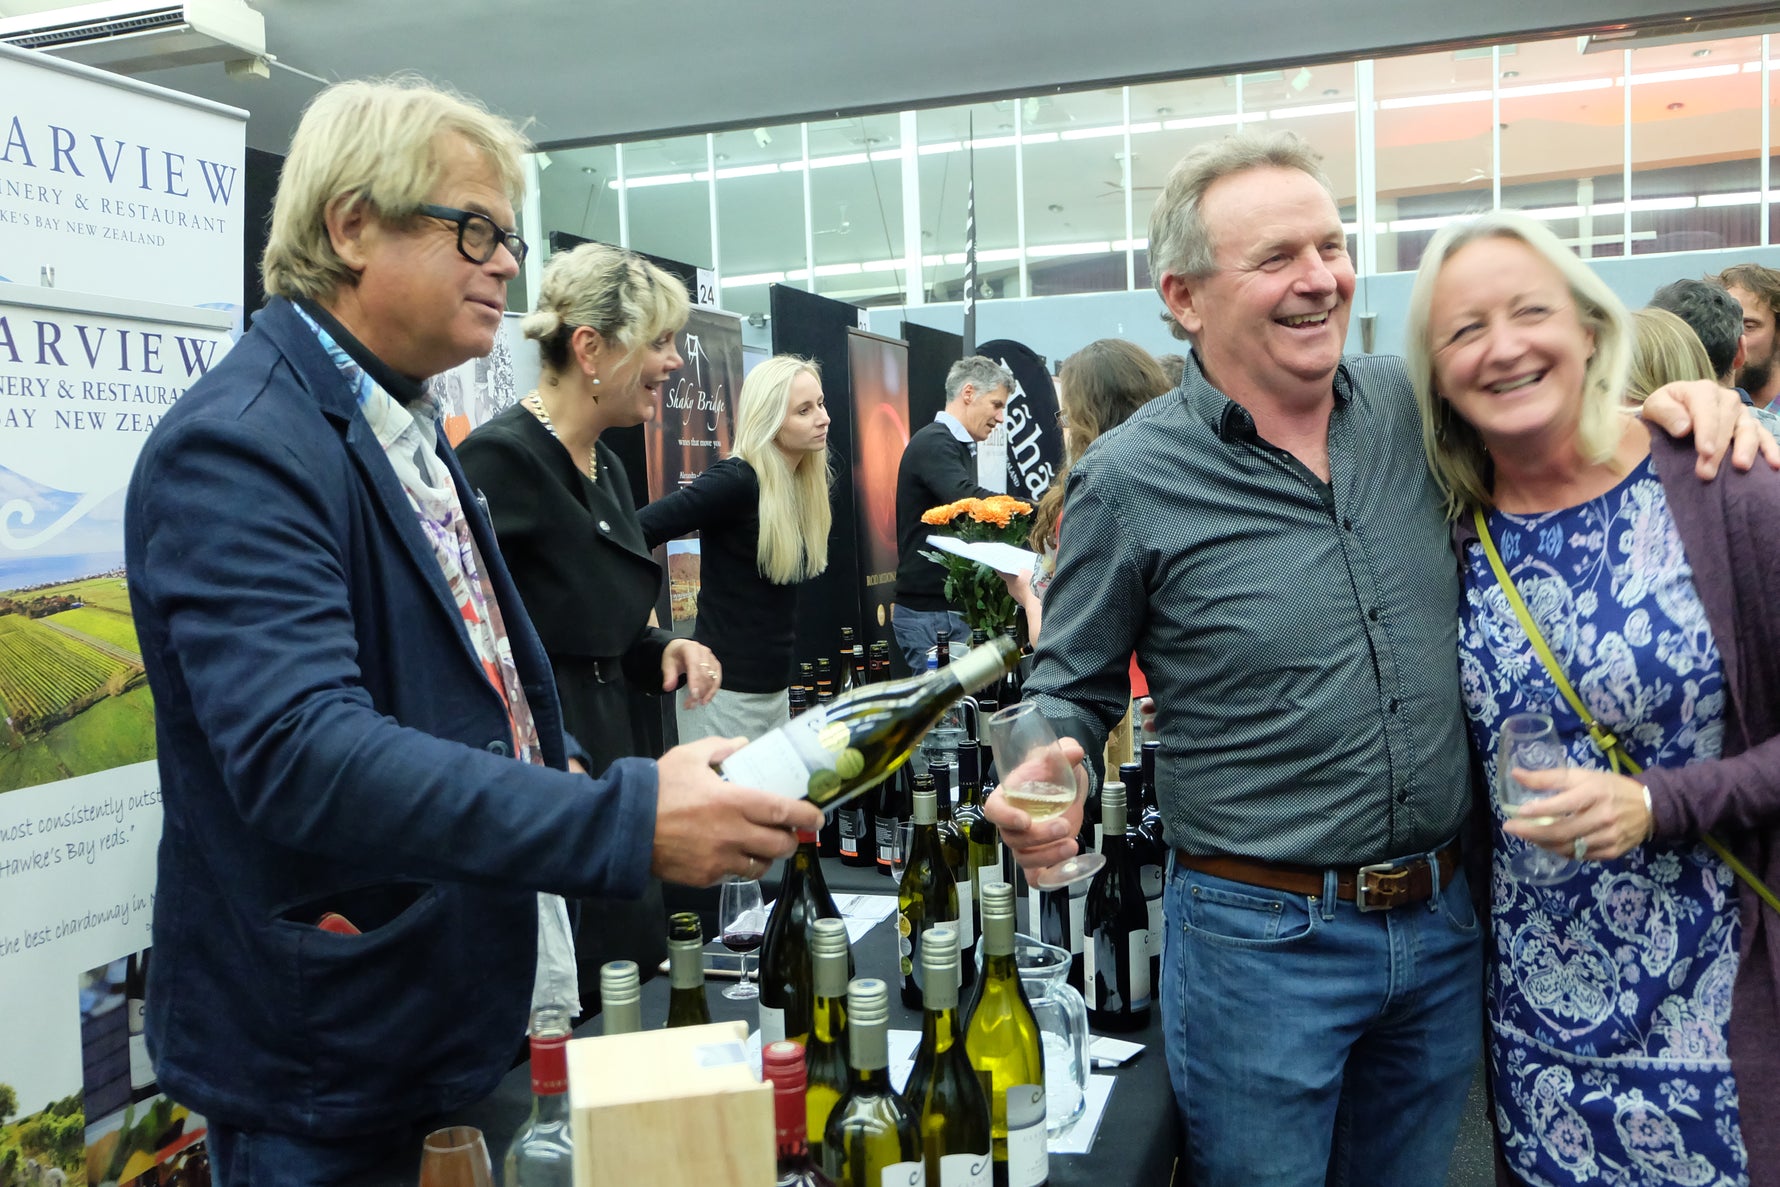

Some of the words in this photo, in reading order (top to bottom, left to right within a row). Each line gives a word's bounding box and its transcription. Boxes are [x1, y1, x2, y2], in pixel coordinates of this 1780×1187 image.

[0, 114, 238, 207] ARVIEW
[35, 215, 61, 232] BAY
[66, 220, 97, 237] NEW
[103, 226, 165, 247] ZEALAND
[74, 193, 90, 211] &
[101, 197, 226, 234] RESTAURANT
[700, 284, 715, 305] 24
[0, 316, 218, 378] ARVIEW
[0, 375, 50, 398] ERY
[57, 379, 75, 400] &
[82, 380, 187, 405] RESTAURA
[666, 377, 694, 426] Shaky
[697, 384, 726, 431] Bridge
[0, 407, 37, 428] AY
[55, 409, 106, 431] NEW
[116, 412, 162, 432] ZEA
[38, 796, 124, 833] consistently
[67, 840, 95, 864] Bay
[0, 936, 20, 958] the
[25, 926, 52, 949] best
[55, 901, 130, 938] chardonnay
[132, 893, 147, 912] in
